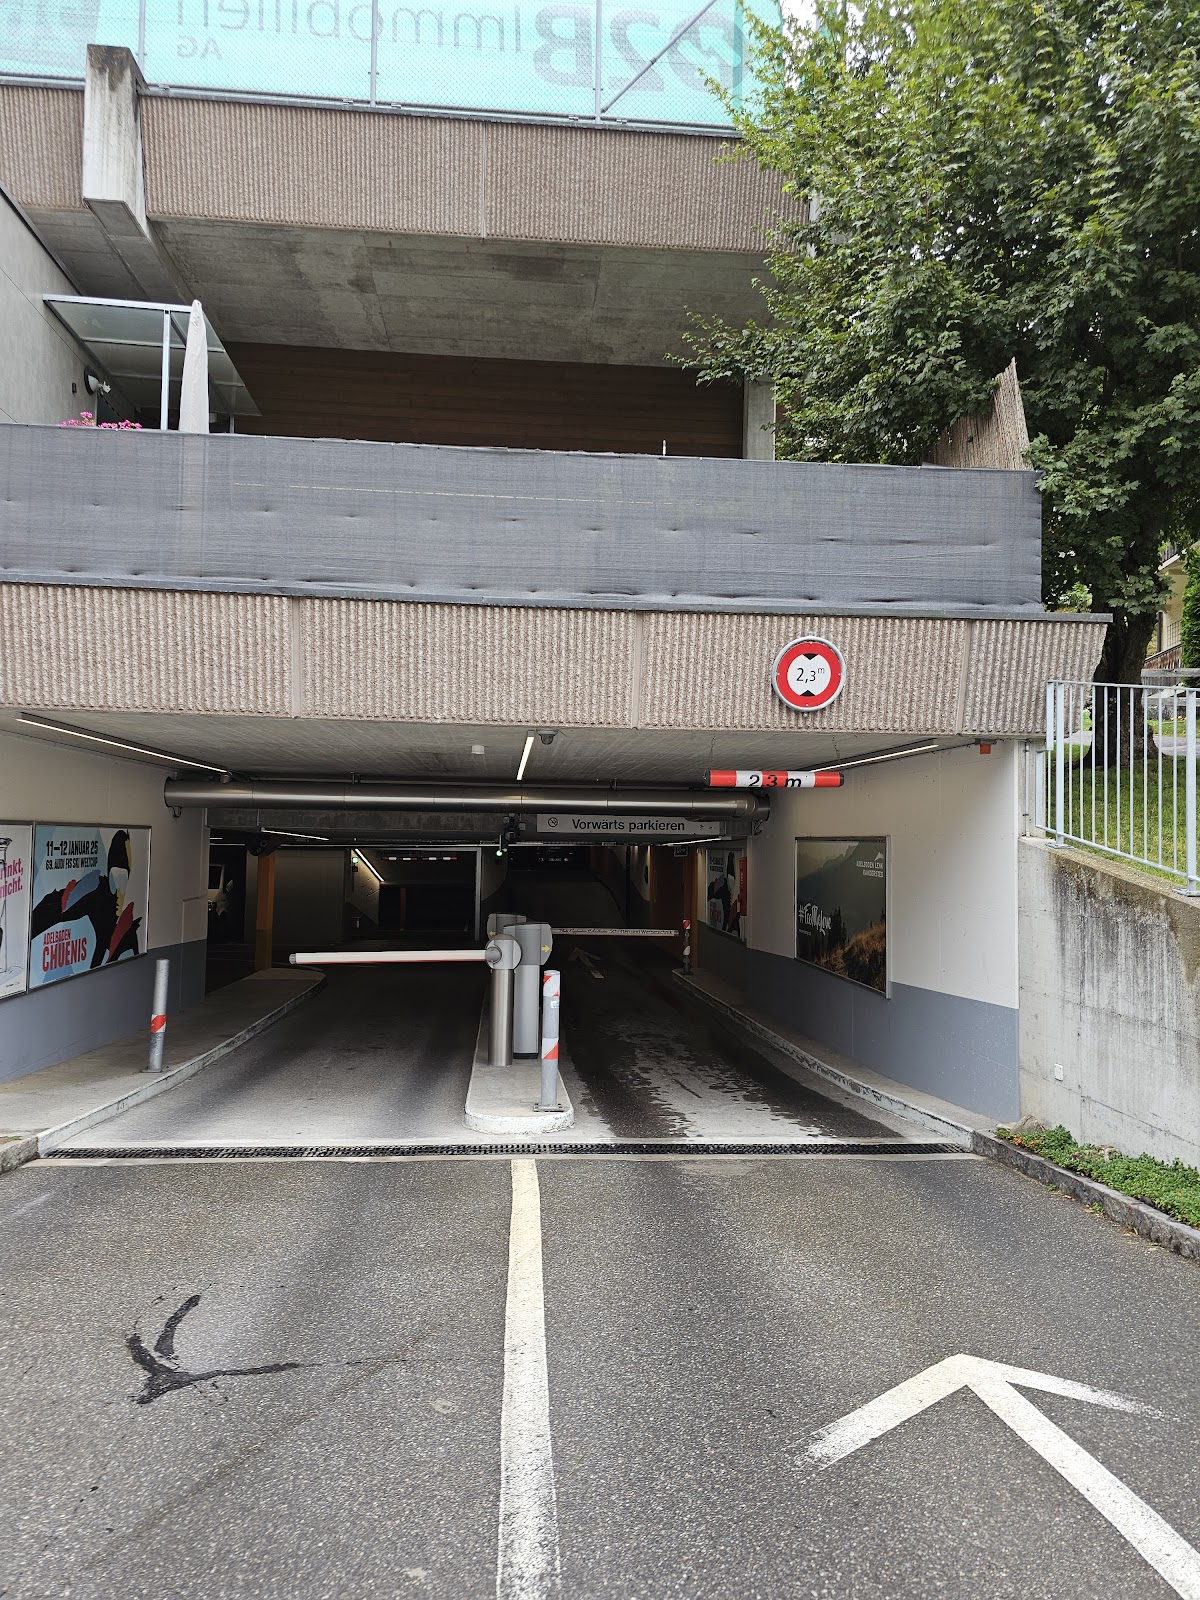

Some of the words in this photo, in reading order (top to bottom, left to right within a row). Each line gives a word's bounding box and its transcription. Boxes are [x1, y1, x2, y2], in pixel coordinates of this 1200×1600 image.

[784, 777, 802, 788] m
[572, 818, 625, 830] Vorwärts
[629, 819, 685, 833] parkieren
[68, 840, 90, 856] JANUAR
[90, 840, 99, 855] 25
[42, 937, 87, 972] CHUENIS
